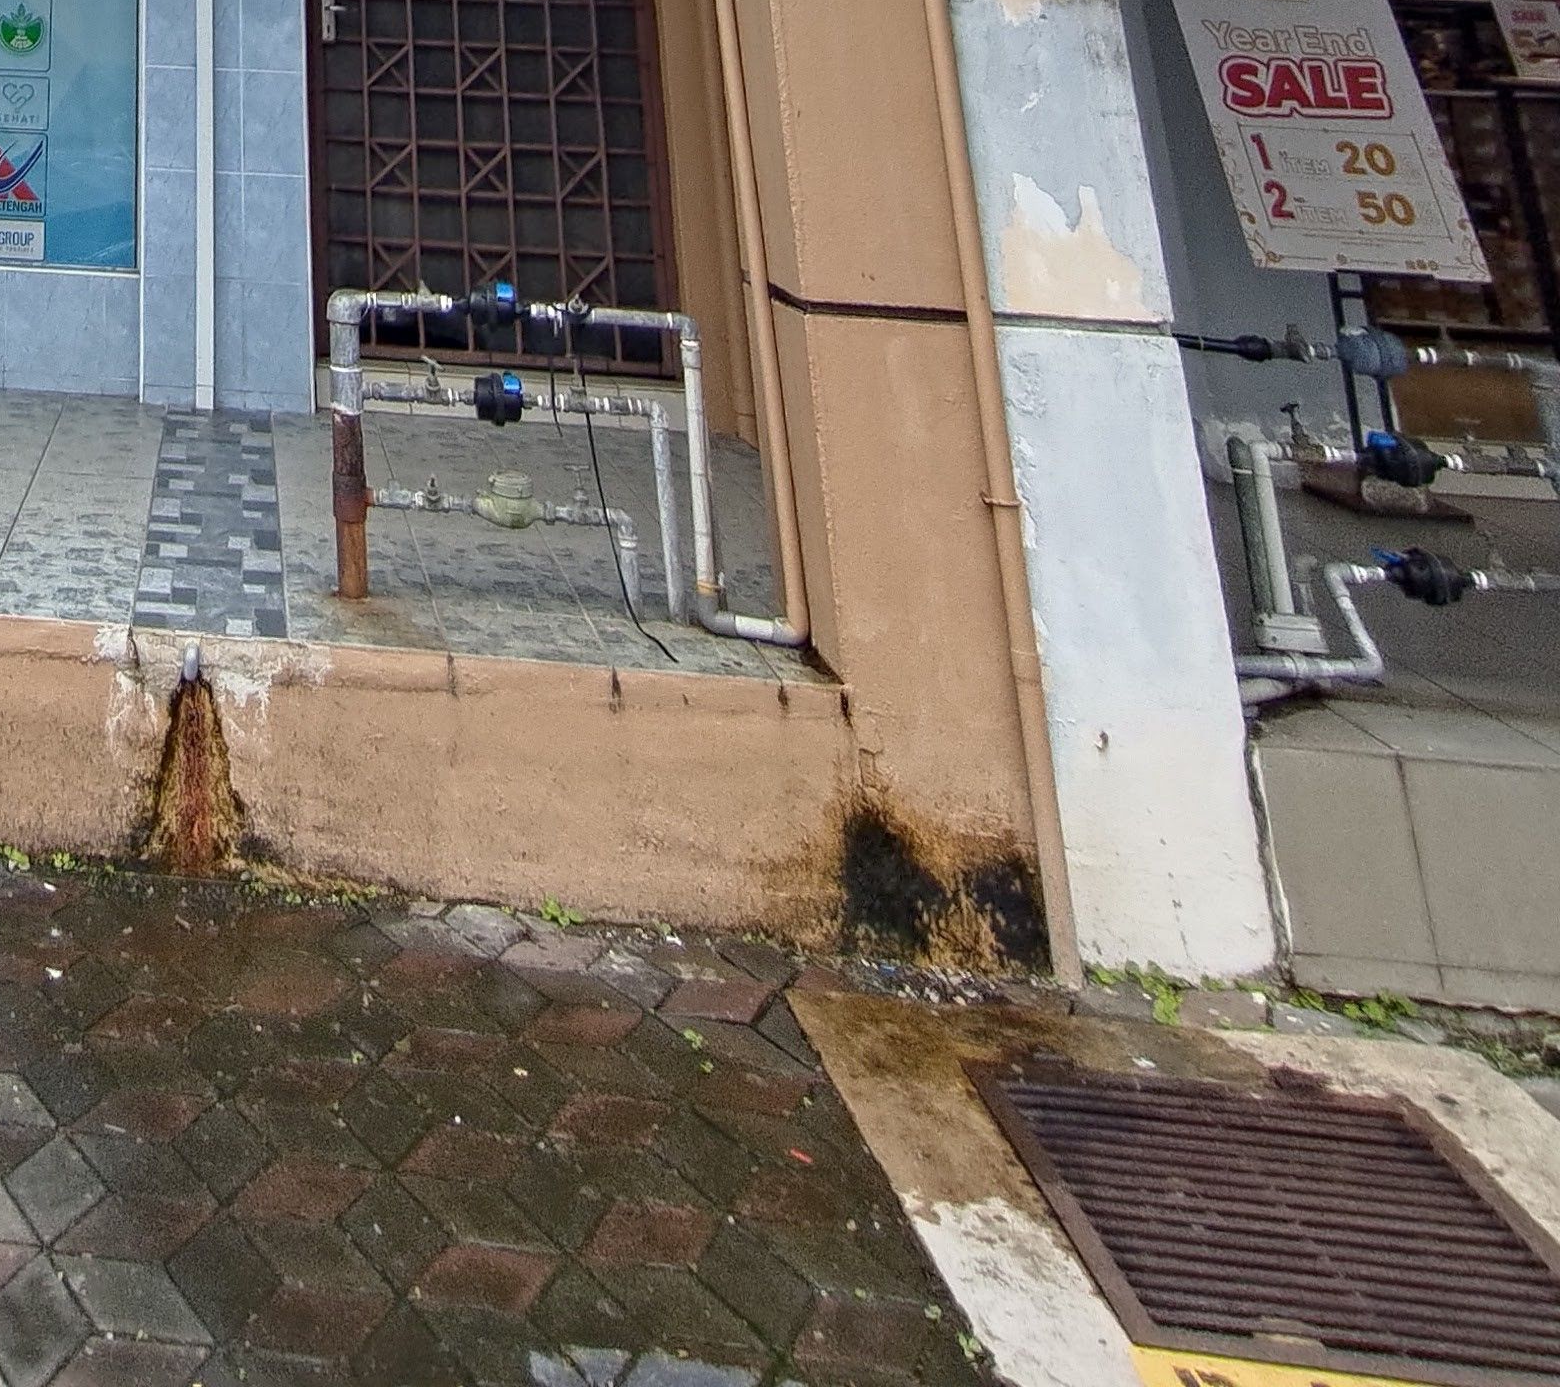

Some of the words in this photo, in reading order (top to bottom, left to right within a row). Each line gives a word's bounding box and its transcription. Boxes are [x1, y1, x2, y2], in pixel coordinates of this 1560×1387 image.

[1202, 19, 1293, 51] Year
[1294, 25, 1376, 58] End
[1222, 59, 1389, 115] SALE
